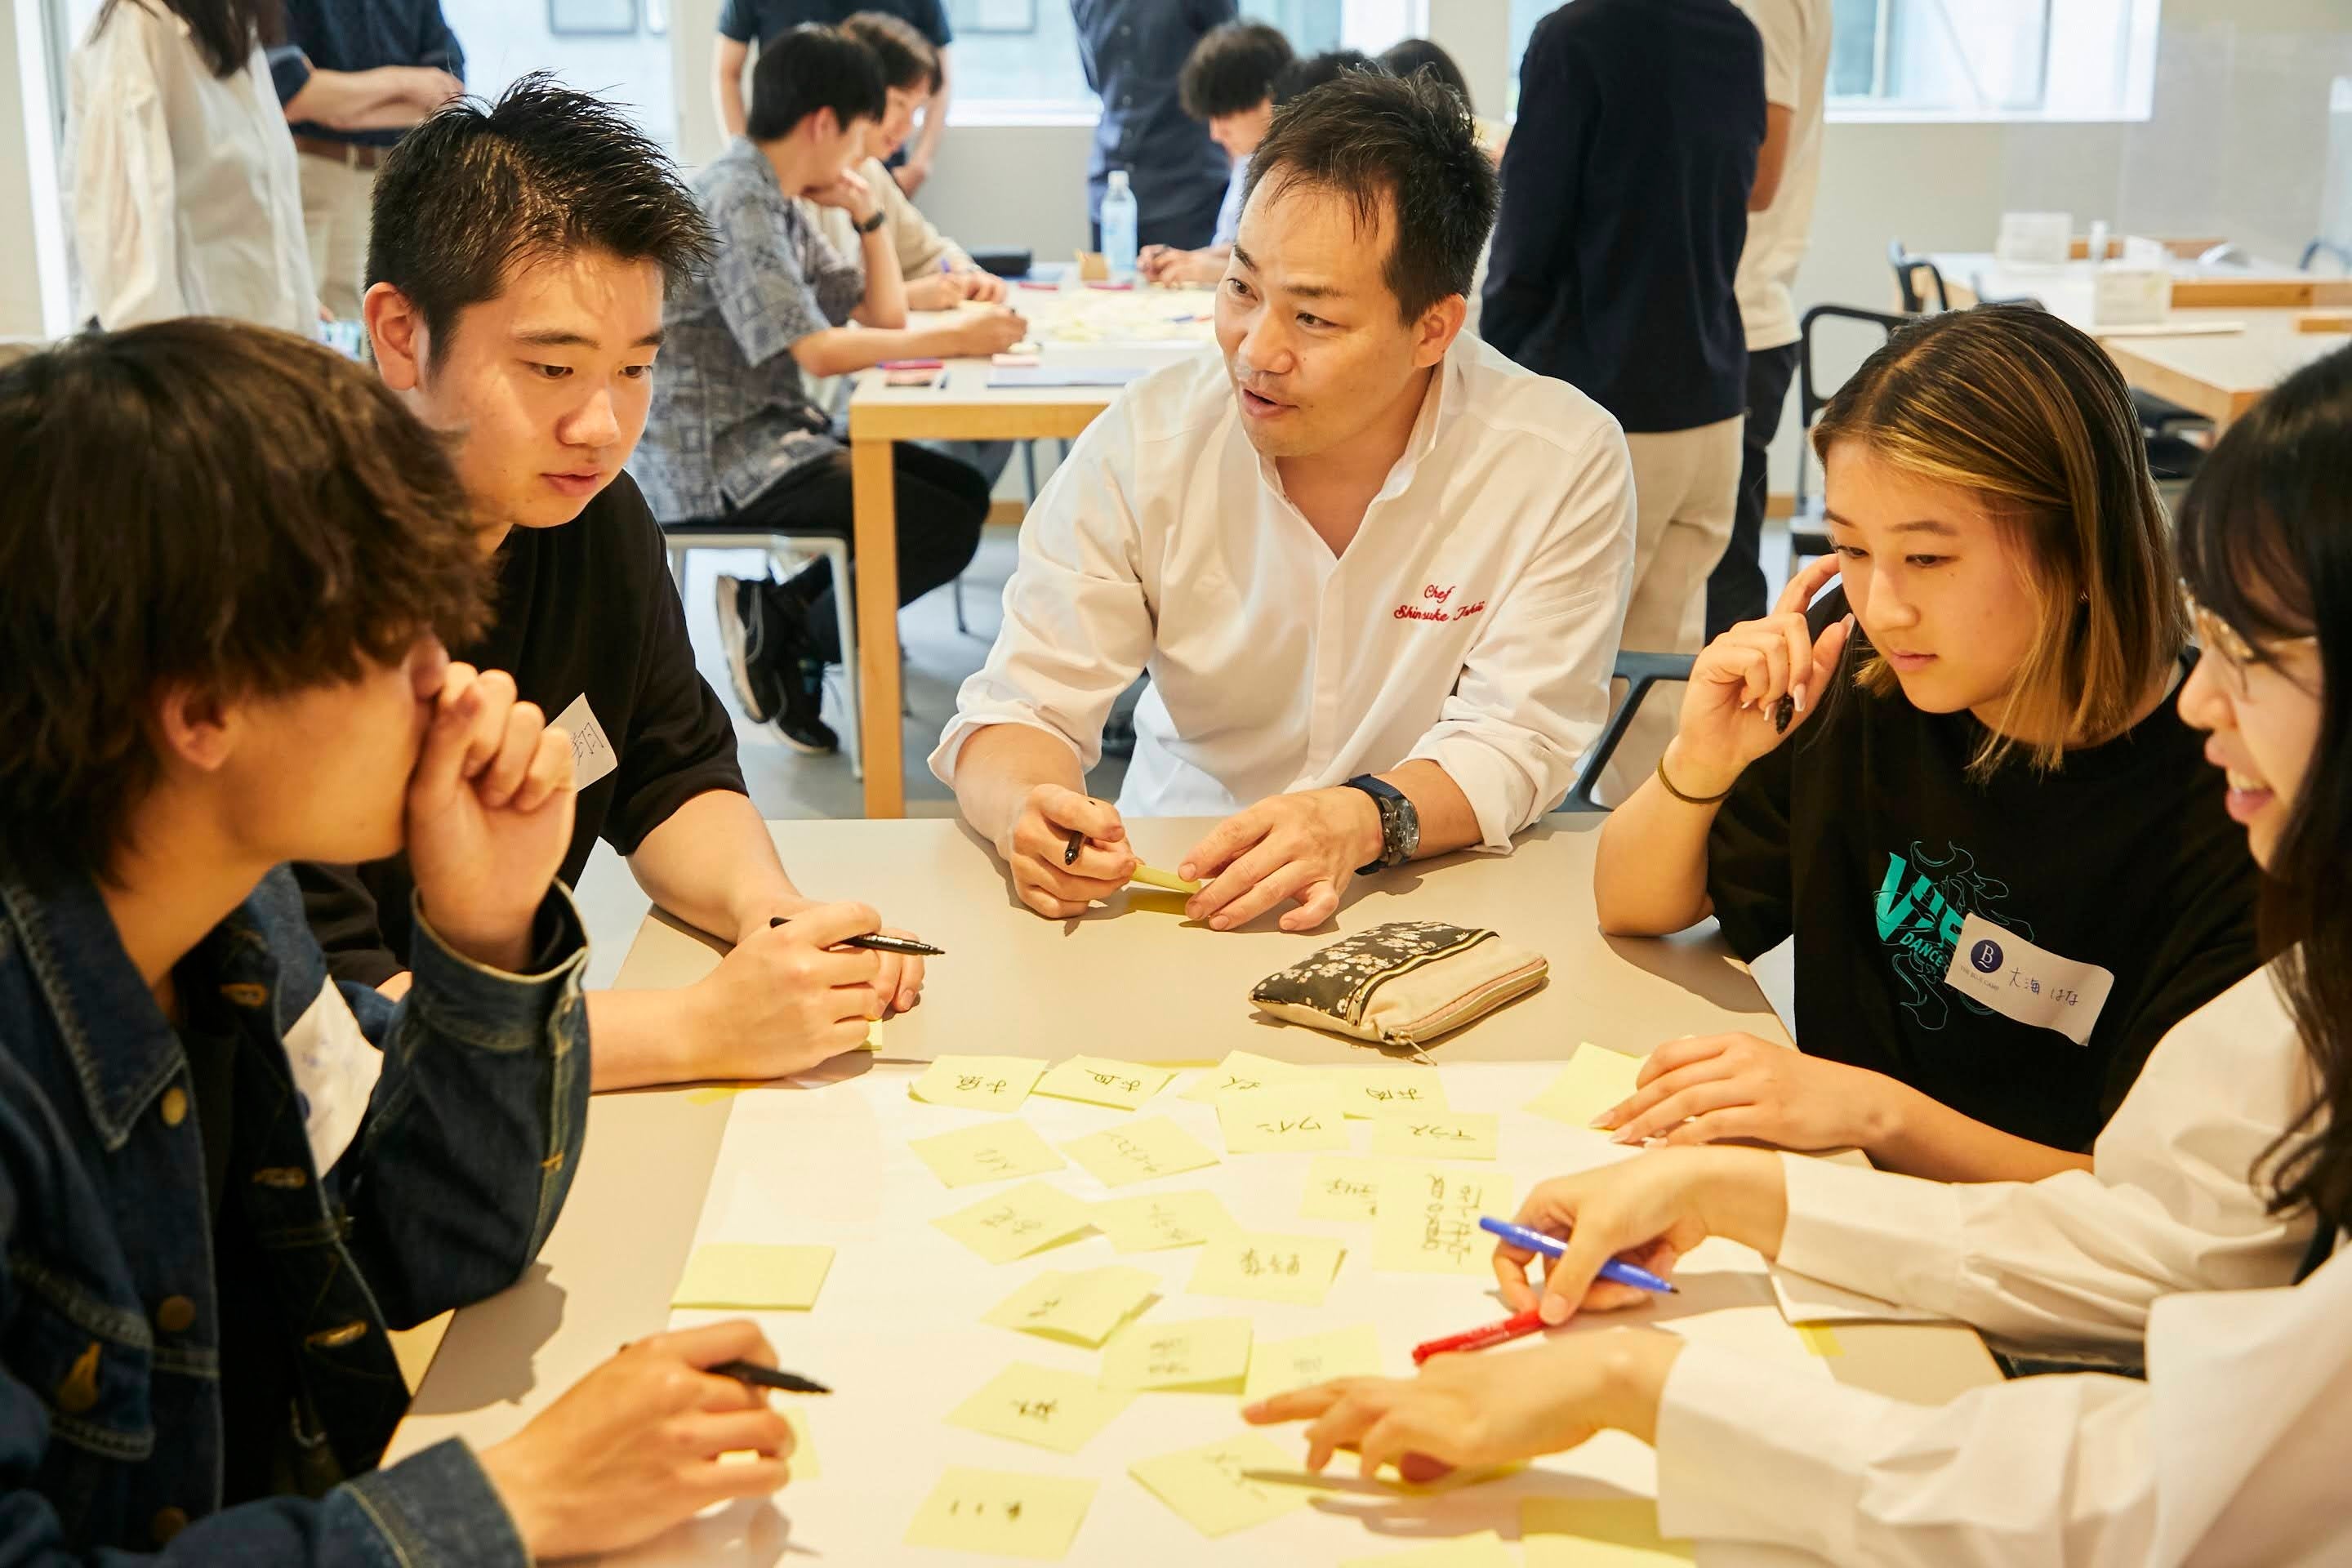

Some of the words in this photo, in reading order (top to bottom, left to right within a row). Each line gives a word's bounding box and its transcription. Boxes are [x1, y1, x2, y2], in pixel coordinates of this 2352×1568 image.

[1423, 585, 1456, 604] Chef
[1393, 604, 1450, 622] Shinsuke
[1900, 932, 1944, 968] DANCE
[1978, 944, 1994, 968] B
[2008, 967, 2041, 996] 大海
[2050, 987, 2078, 1006] はな
[1256, 1116, 1321, 1134] ワイン
